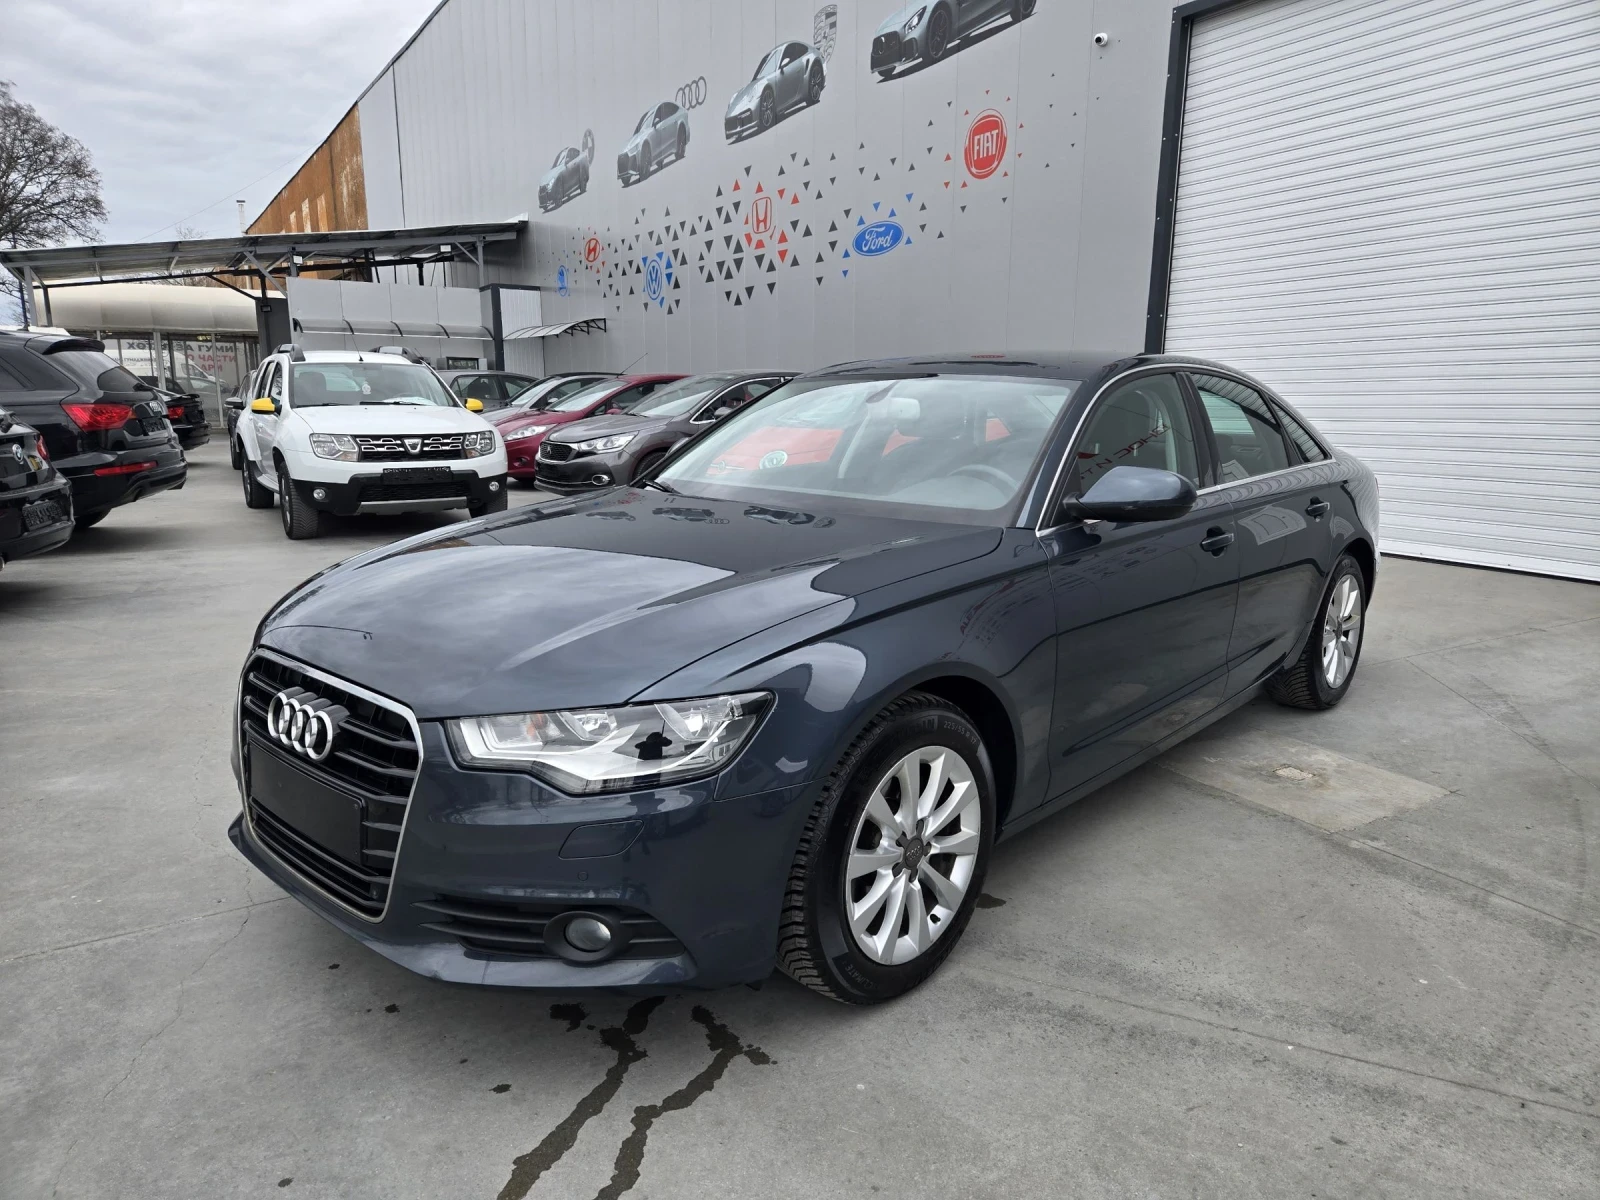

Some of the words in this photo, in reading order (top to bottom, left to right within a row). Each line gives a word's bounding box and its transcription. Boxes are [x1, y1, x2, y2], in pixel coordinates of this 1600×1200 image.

[973, 129, 999, 161] FIAT
[862, 226, 894, 251] Ford
[198, 344, 234, 353] ГУМИ
